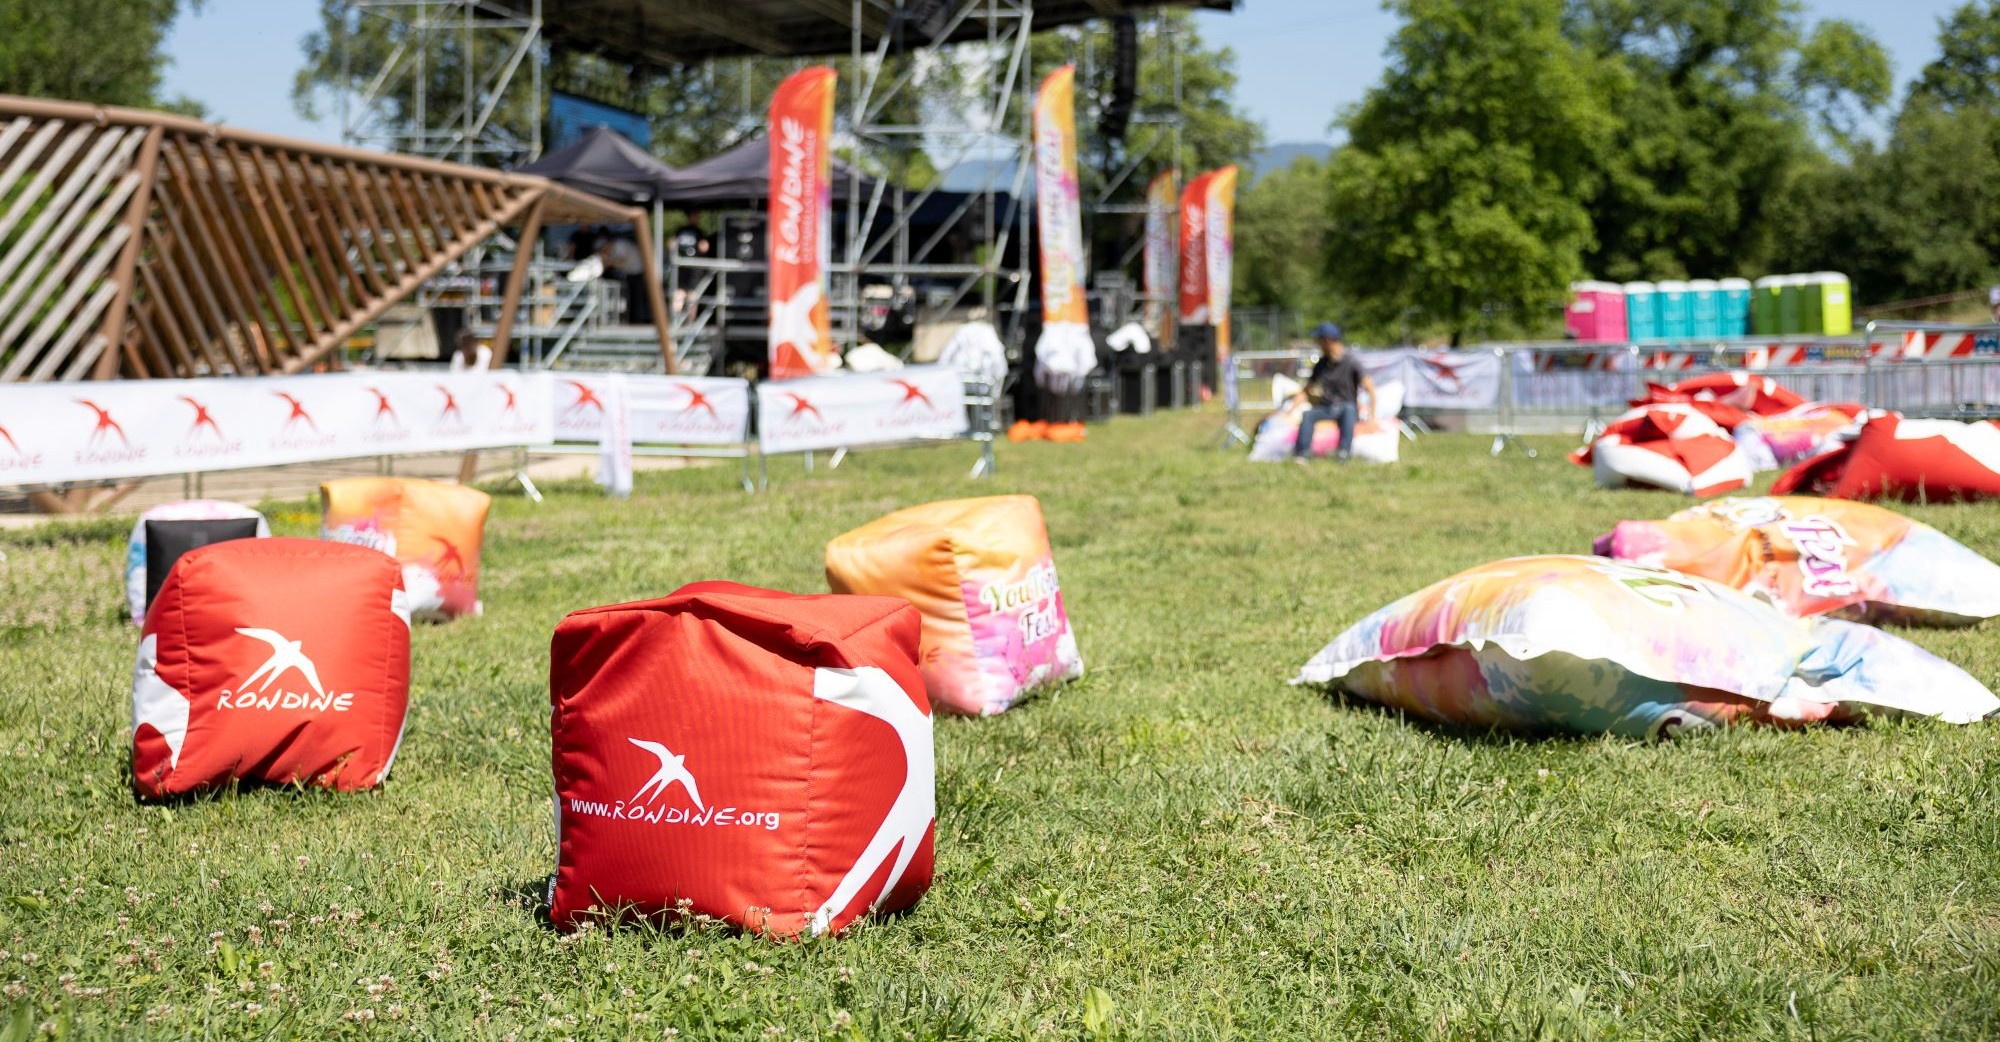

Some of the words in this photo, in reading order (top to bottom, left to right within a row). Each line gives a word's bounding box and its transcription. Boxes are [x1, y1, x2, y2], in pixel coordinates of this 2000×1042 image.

[776, 115, 804, 265] RONDINE
[216, 689, 354, 712] RONDINE
[571, 799, 780, 831] www.RONDINE.org
